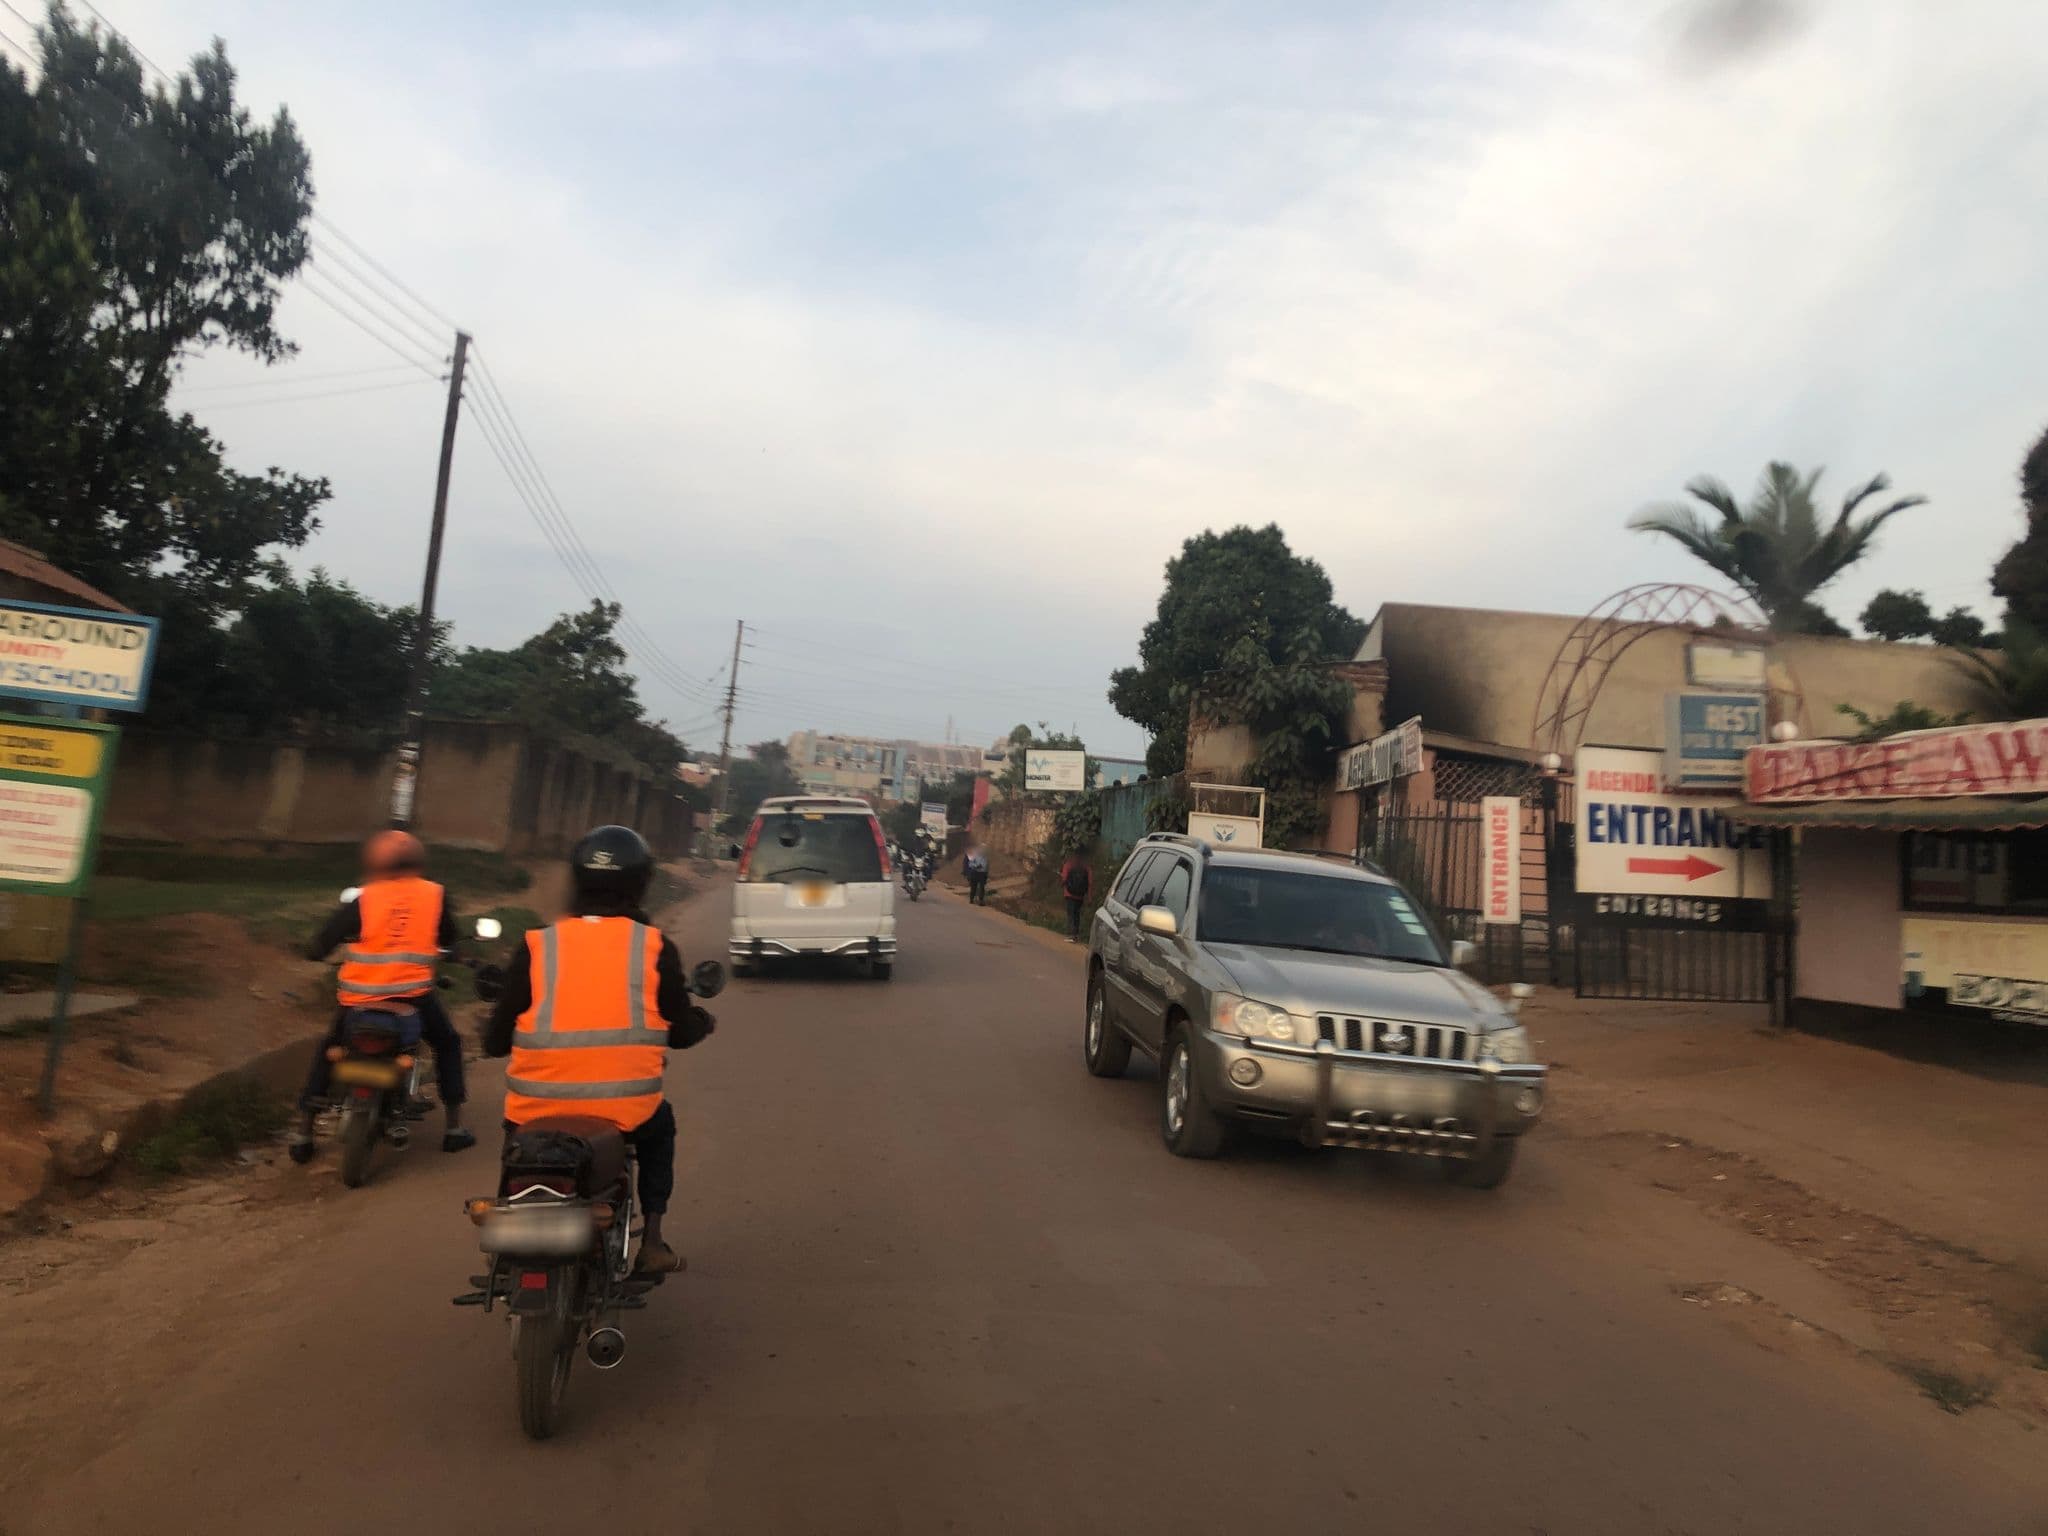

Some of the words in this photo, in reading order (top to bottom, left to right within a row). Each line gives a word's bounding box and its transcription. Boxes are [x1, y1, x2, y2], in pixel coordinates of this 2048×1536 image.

[1586, 769, 1657, 793] AGENDA
[1764, 742, 1914, 799] TAKE
[1937, 727, 2048, 793] AW
[1491, 805, 1508, 917] ENTRANCE
